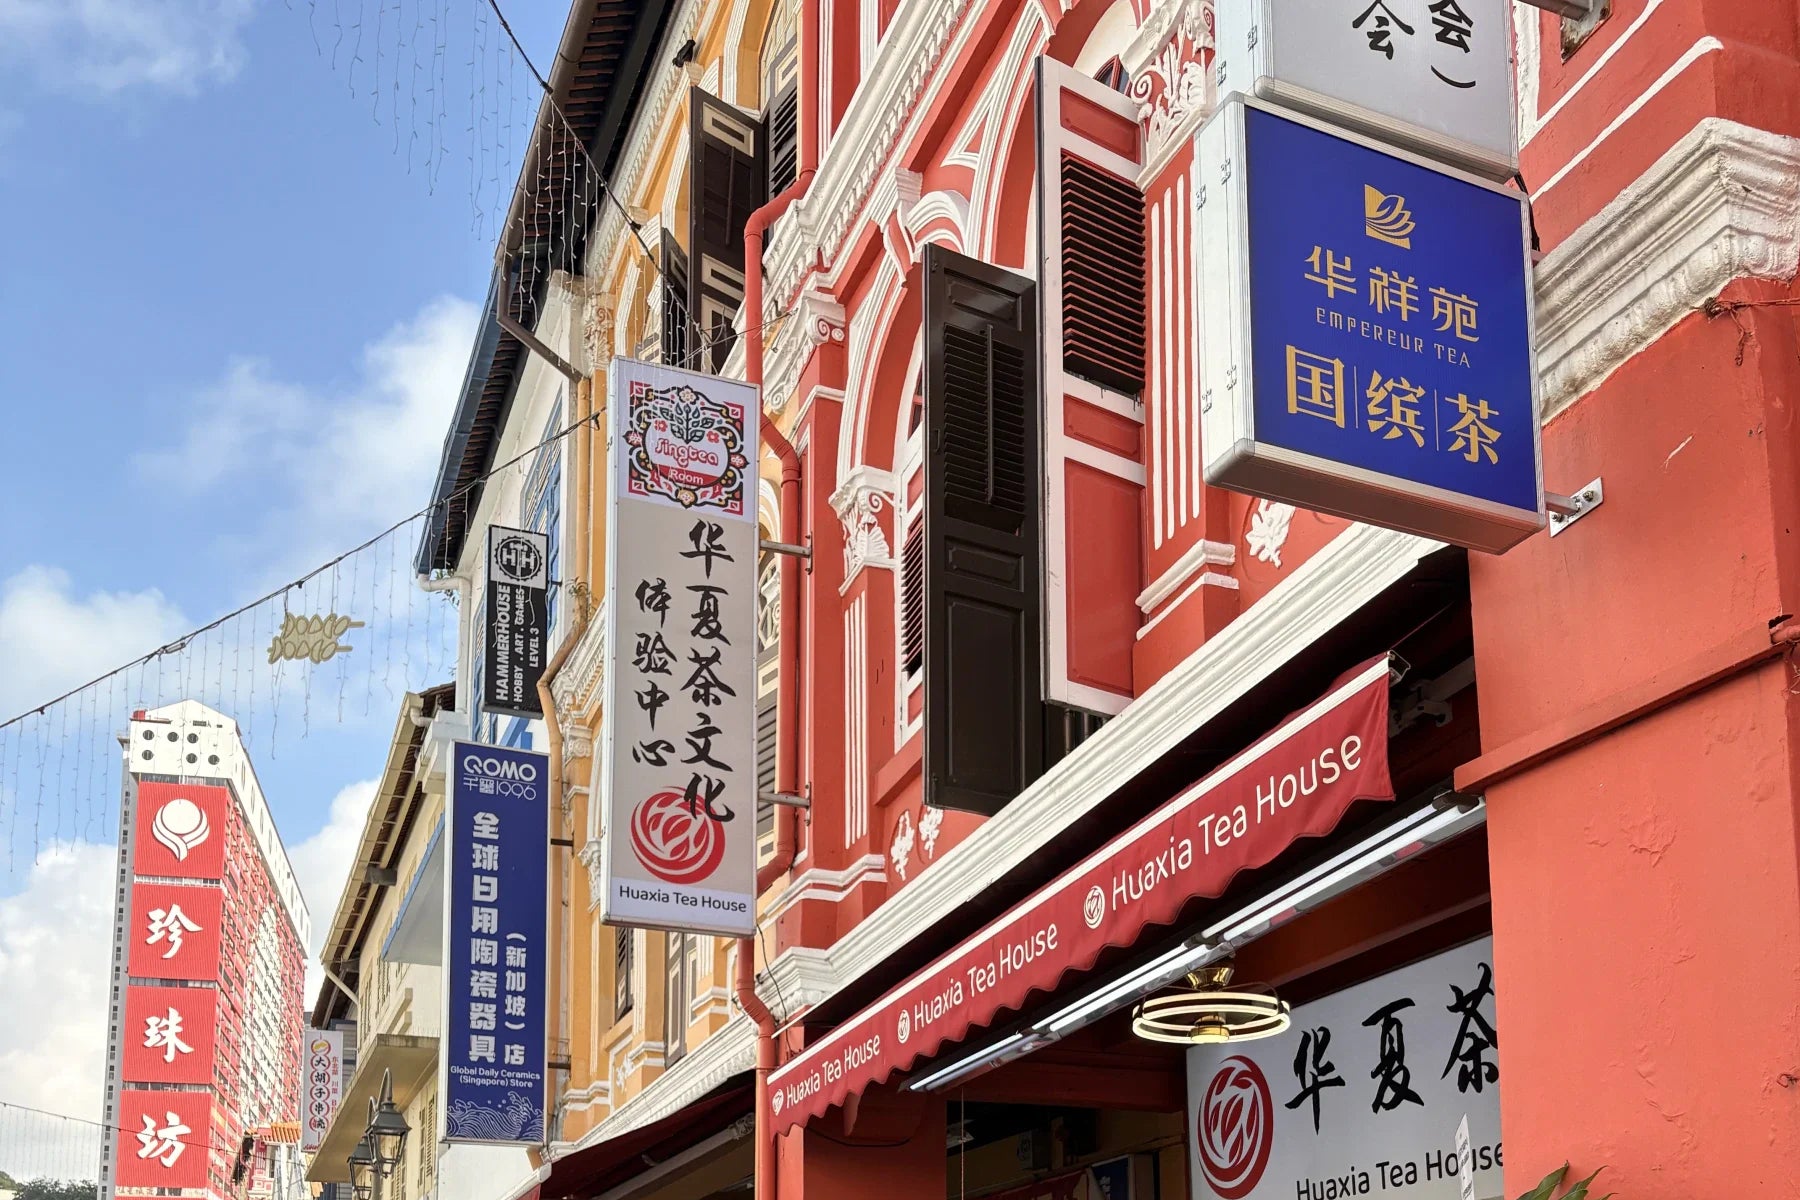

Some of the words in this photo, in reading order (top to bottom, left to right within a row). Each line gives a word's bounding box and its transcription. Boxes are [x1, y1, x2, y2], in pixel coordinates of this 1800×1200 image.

[1352, 0, 1415, 60] 会
[1304, 245, 1480, 343] 华祥苑
[1316, 307, 1424, 355] EMPEREUR
[1433, 343, 1472, 368] TEA
[668, 471, 704, 486] Room
[514, 588, 526, 625] GAMES
[495, 584, 511, 701] HAMMERHOUSE
[513, 632, 524, 654] ART
[529, 626, 540, 638] 3
[529, 640, 540, 668] LEVEL
[513, 665, 524, 703] HOBBY
[632, 578, 678, 768] 体验中心
[680, 518, 736, 822] 华夏茶文化
[463, 754, 537, 782] QOMO
[495, 780, 537, 801] 1996
[1112, 838, 1193, 911] Huaxia
[1200, 803, 1248, 858] Tea
[1257, 733, 1363, 824] House
[619, 884, 670, 903] Huaxia
[672, 891, 698, 907] Tea
[701, 895, 747, 912] House
[468, 811, 500, 1063] 全球日用陶瓷器具
[914, 977, 963, 1032] Huaxia
[967, 960, 997, 999] Tea
[999, 921, 1060, 987] House
[136, 903, 204, 1168] 珍珠坊
[1284, 962, 1499, 1136] 华夏茶
[450, 1065, 477, 1076] Global
[478, 1066, 499, 1078] Daily
[500, 1069, 541, 1081] Ceramics
[459, 1074, 508, 1087] (Singapore)
[509, 1078, 534, 1089] Store
[786, 1067, 821, 1109] Huaxia
[821, 1052, 842, 1083] Tea
[844, 1031, 881, 1073] House
[1375, 1150, 1419, 1190] Tea
